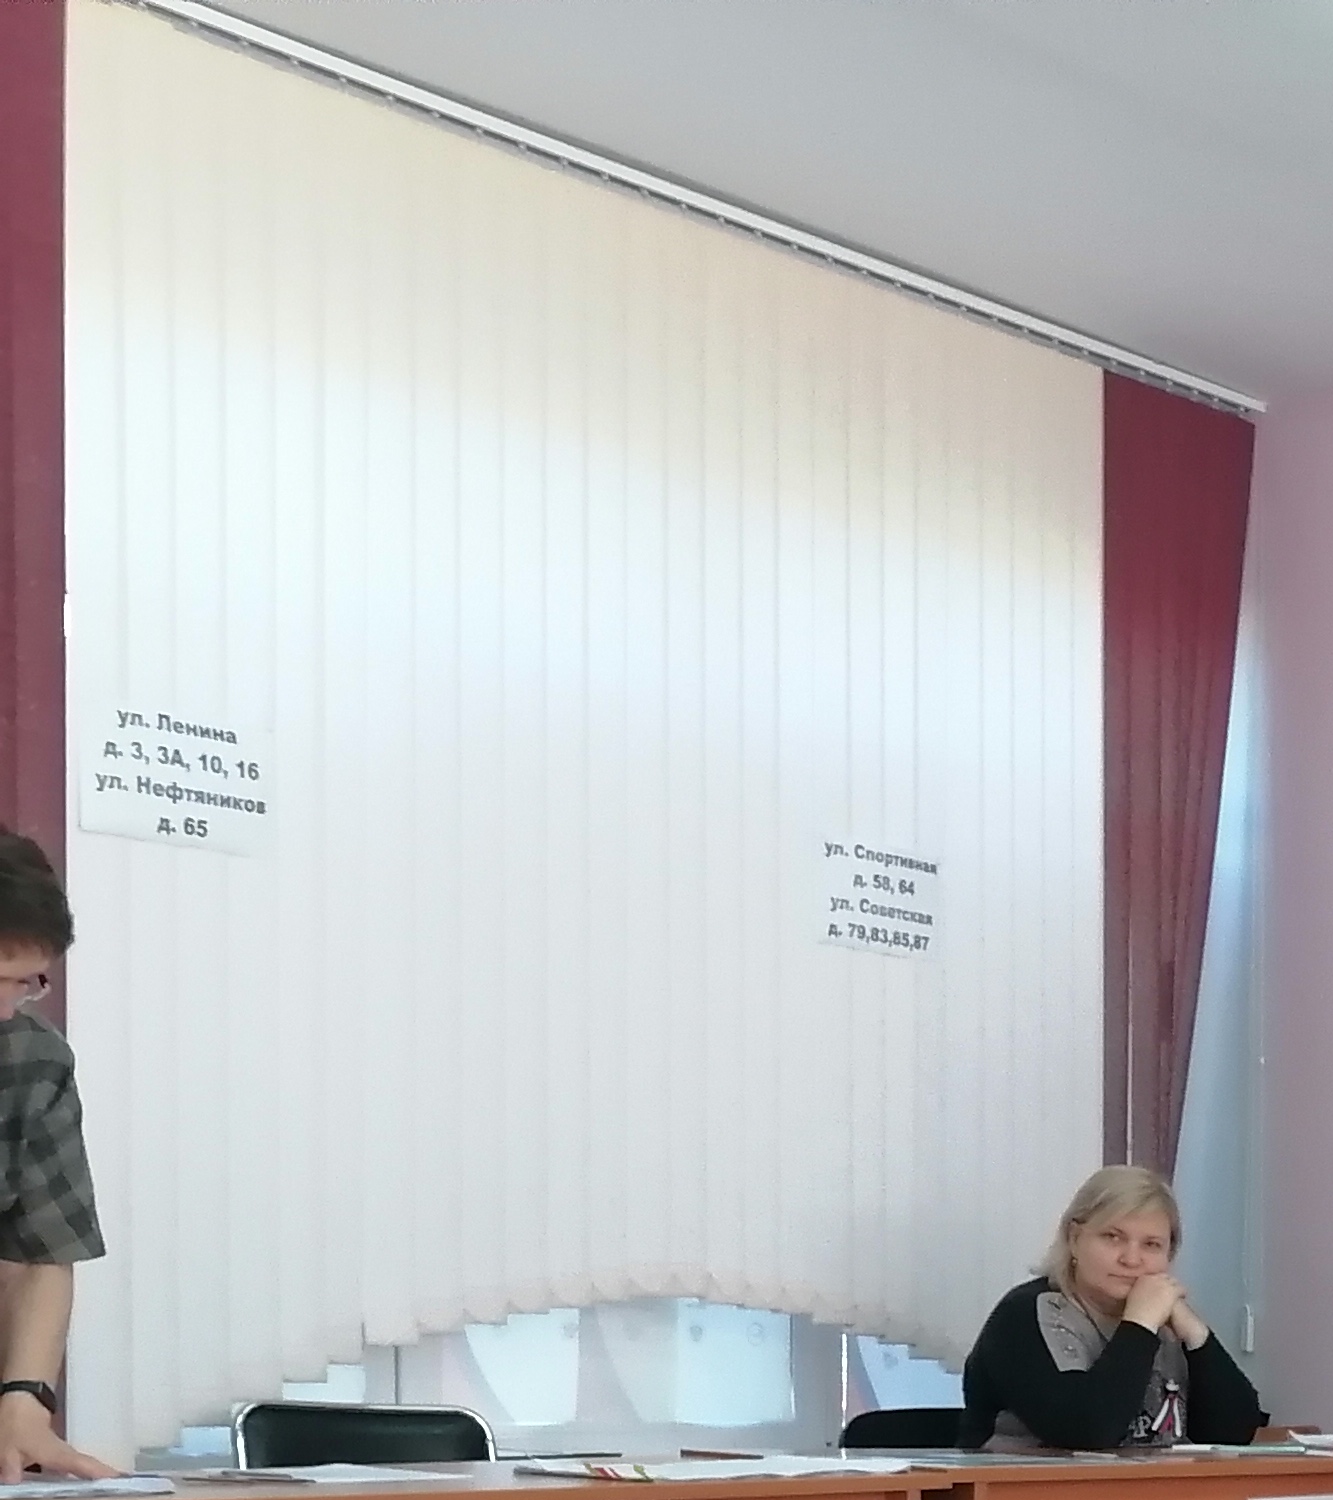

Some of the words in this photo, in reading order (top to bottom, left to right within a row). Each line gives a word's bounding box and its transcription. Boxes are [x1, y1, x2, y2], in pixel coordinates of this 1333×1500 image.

[117, 708, 150, 728] ул.
[157, 713, 238, 745] Ленина
[104, 740, 123, 759] д.
[131, 742, 150, 765] 3,
[157, 746, 191, 773] 3А,
[199, 754, 229, 779] 10,
[236, 761, 260, 781] 16
[95, 773, 128, 792] ул.
[137, 775, 268, 815] Нефтяников
[157, 817, 176, 835] д.
[184, 817, 209, 838] 65
[824, 842, 849, 857] ул.
[854, 844, 938, 875] Спортивная
[853, 874, 867, 888] д.
[873, 874, 895, 894] 58,
[899, 879, 916, 896] 64
[830, 897, 854, 912] ул.
[859, 898, 934, 926] Советская
[828, 923, 842, 938] д.
[848, 922, 930, 951] 79,83,85,87
